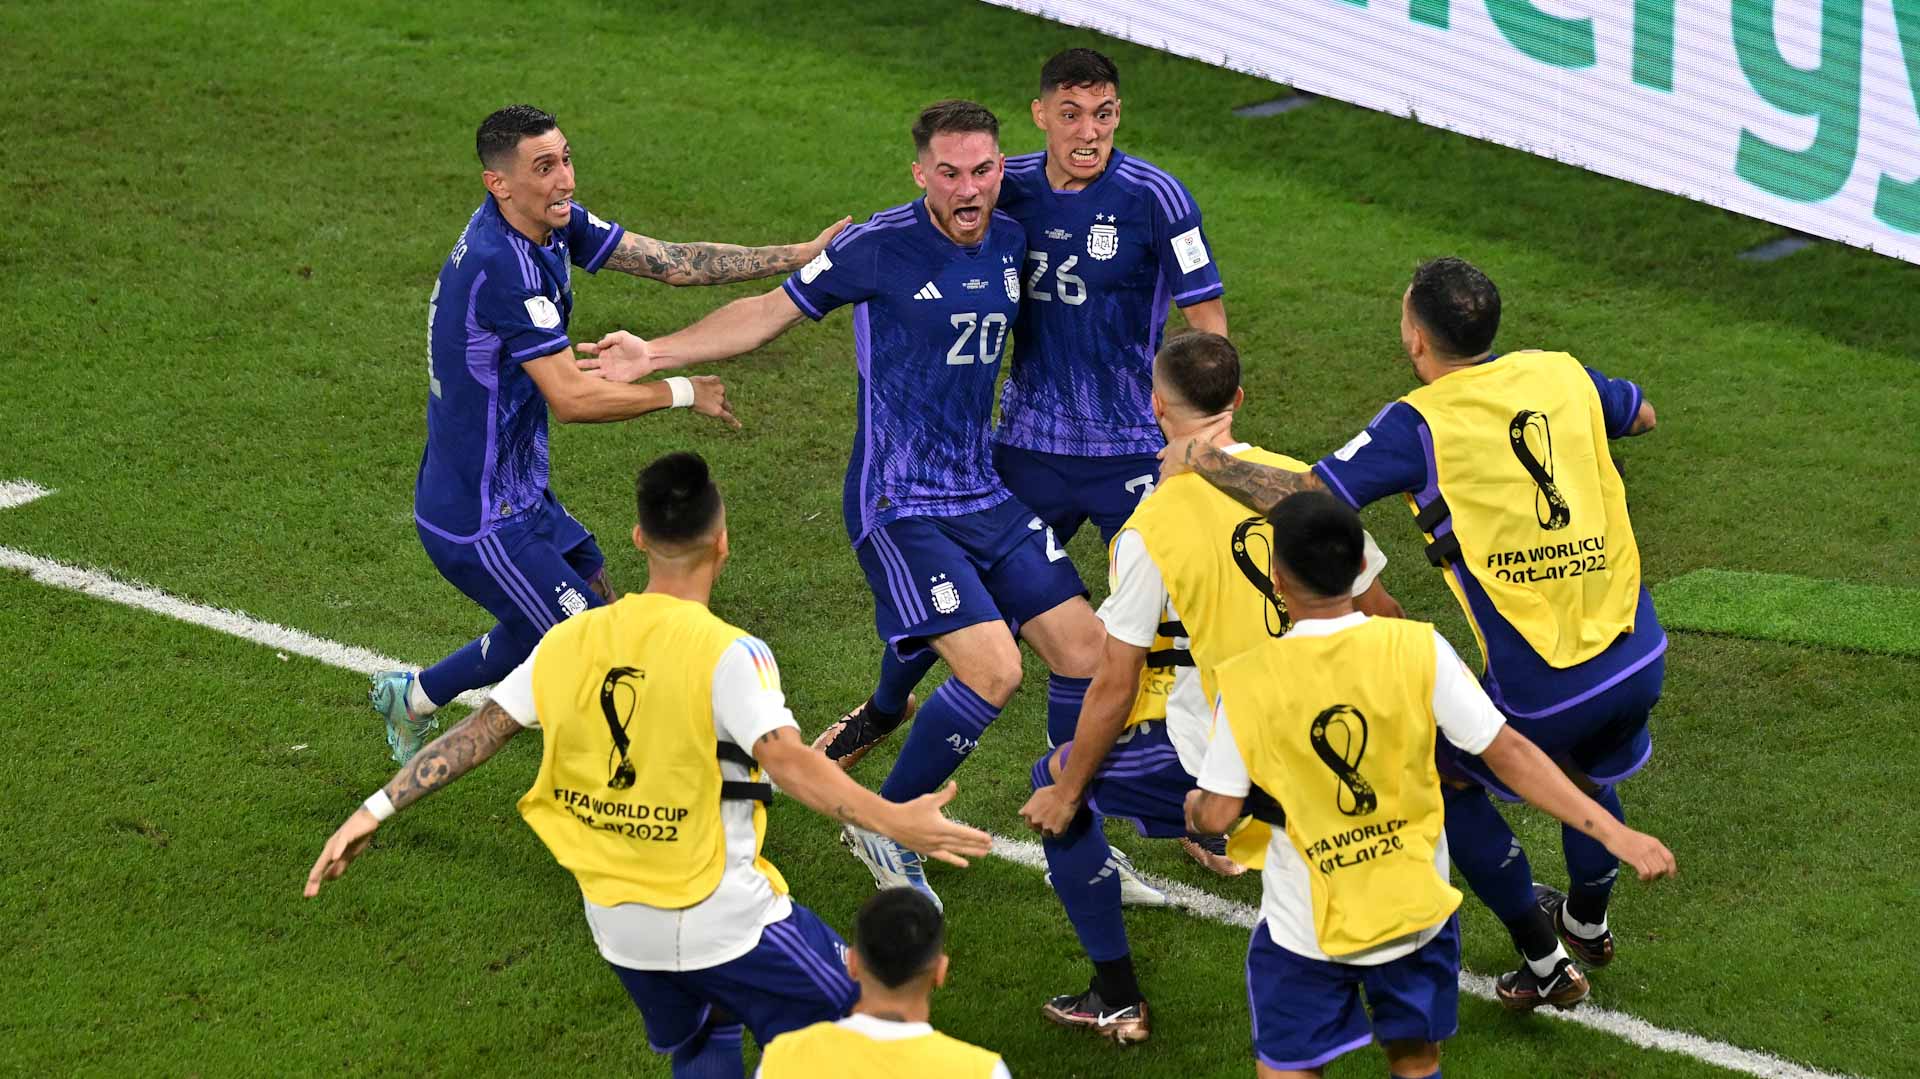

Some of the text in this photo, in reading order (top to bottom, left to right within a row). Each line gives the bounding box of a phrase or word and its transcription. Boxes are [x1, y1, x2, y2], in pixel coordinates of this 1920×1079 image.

[1028, 250, 1087, 305] 26
[946, 312, 1008, 365] 20
[1487, 551, 1526, 568] FIFA
[1528, 541, 1582, 562] WORL
[554, 789, 688, 822] FIFA WORLD CUP
[1305, 838, 1332, 861] FFA
